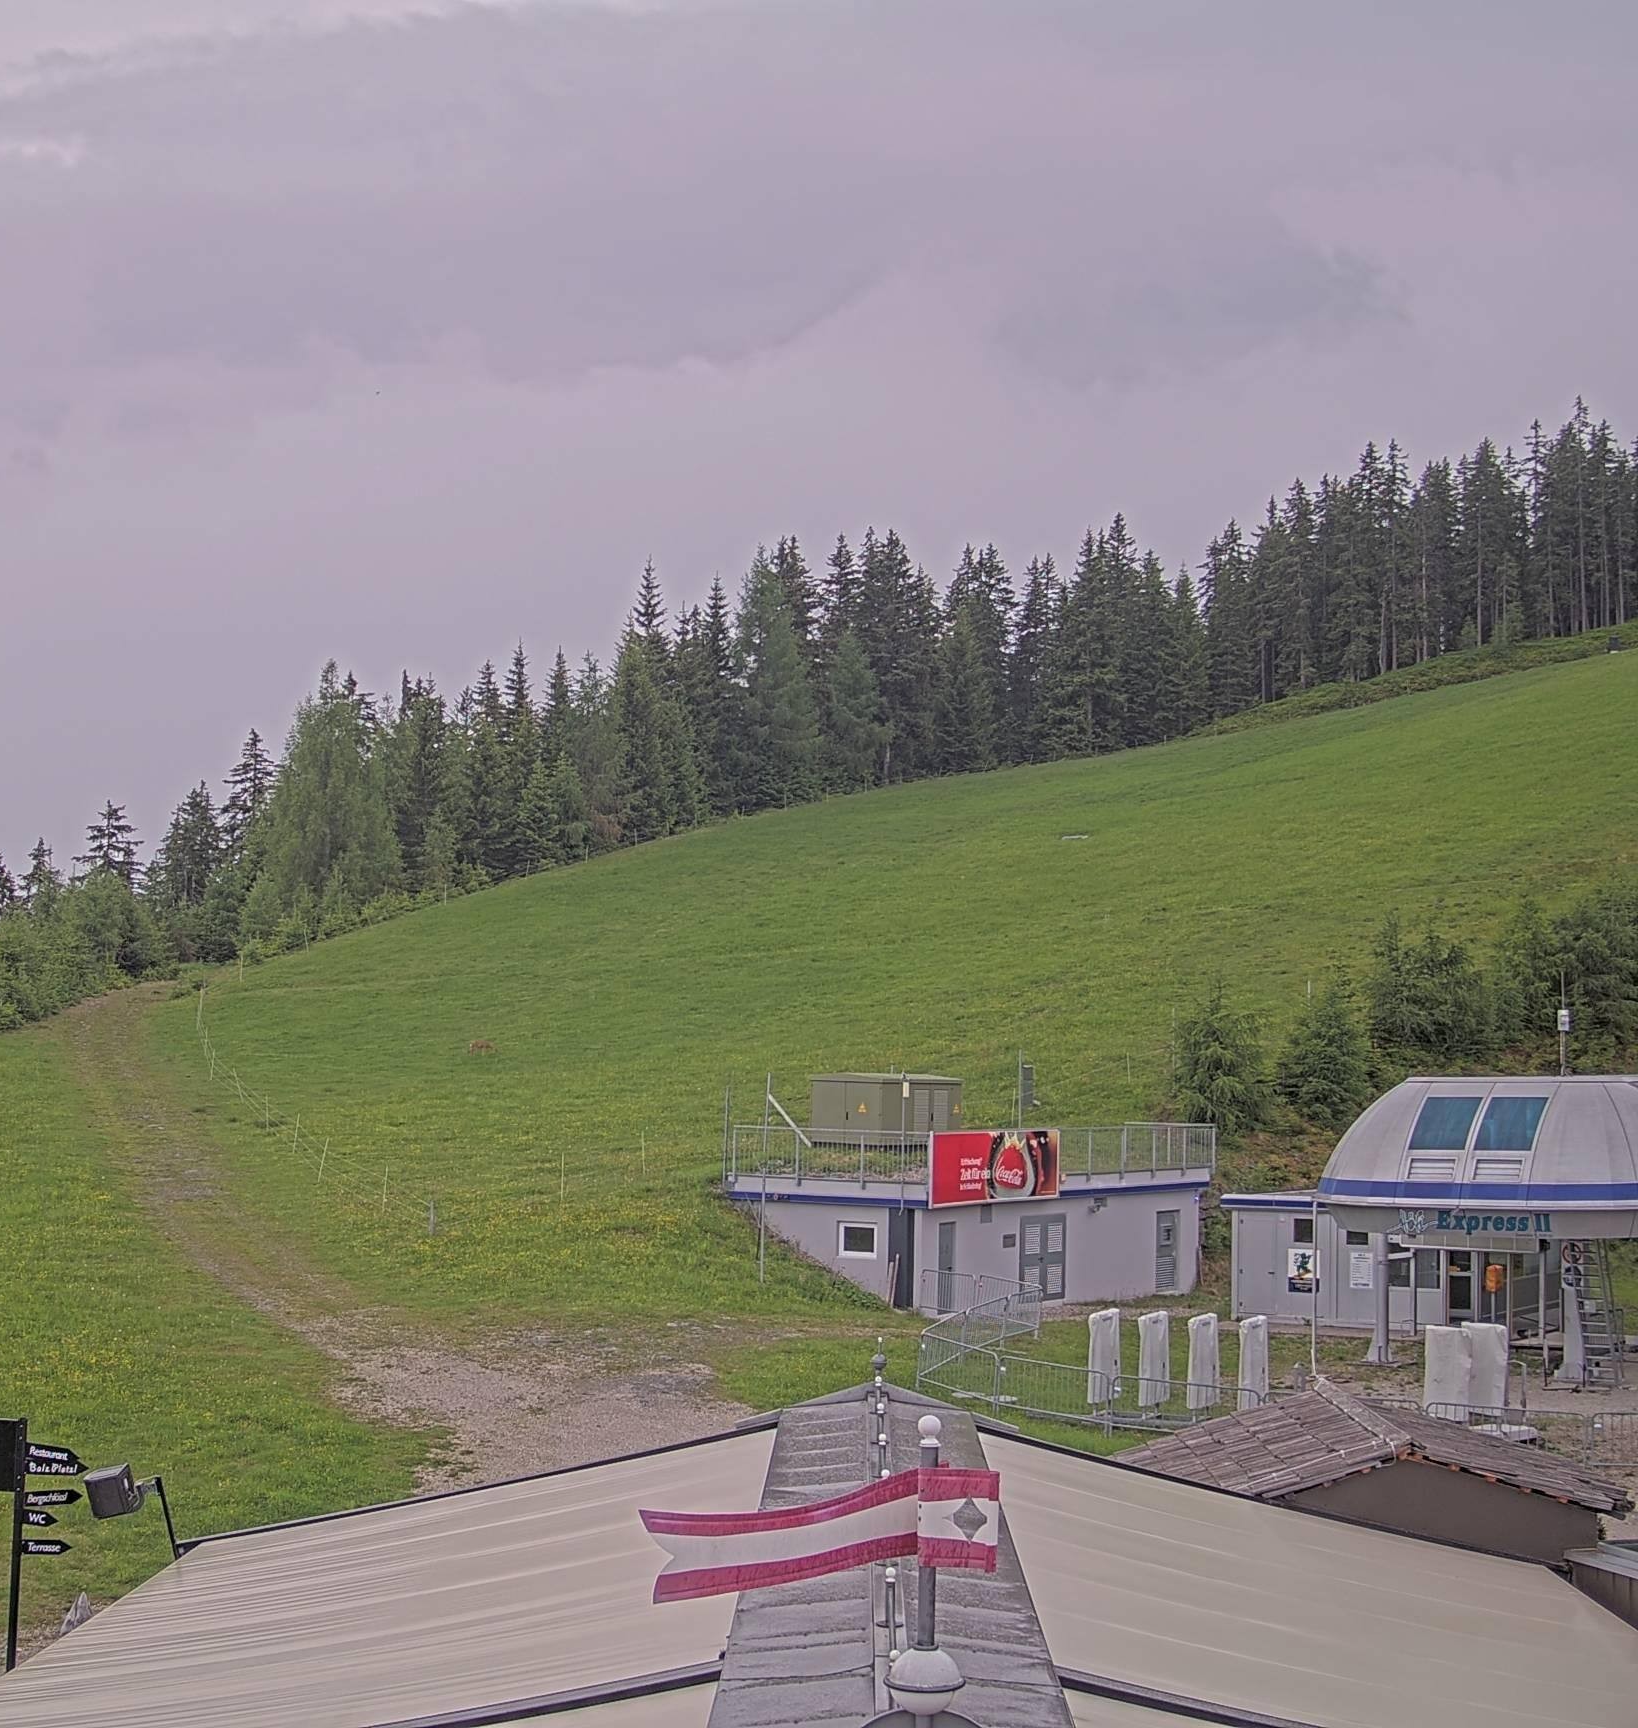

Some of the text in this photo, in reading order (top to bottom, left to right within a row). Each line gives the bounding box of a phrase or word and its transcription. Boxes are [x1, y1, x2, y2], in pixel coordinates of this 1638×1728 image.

[1436, 1210, 1529, 1235] Express
[29, 1445, 68, 1460] Restaurant
[29, 1513, 46, 1524] WC
[27, 1542, 61, 1553] Terrasse
